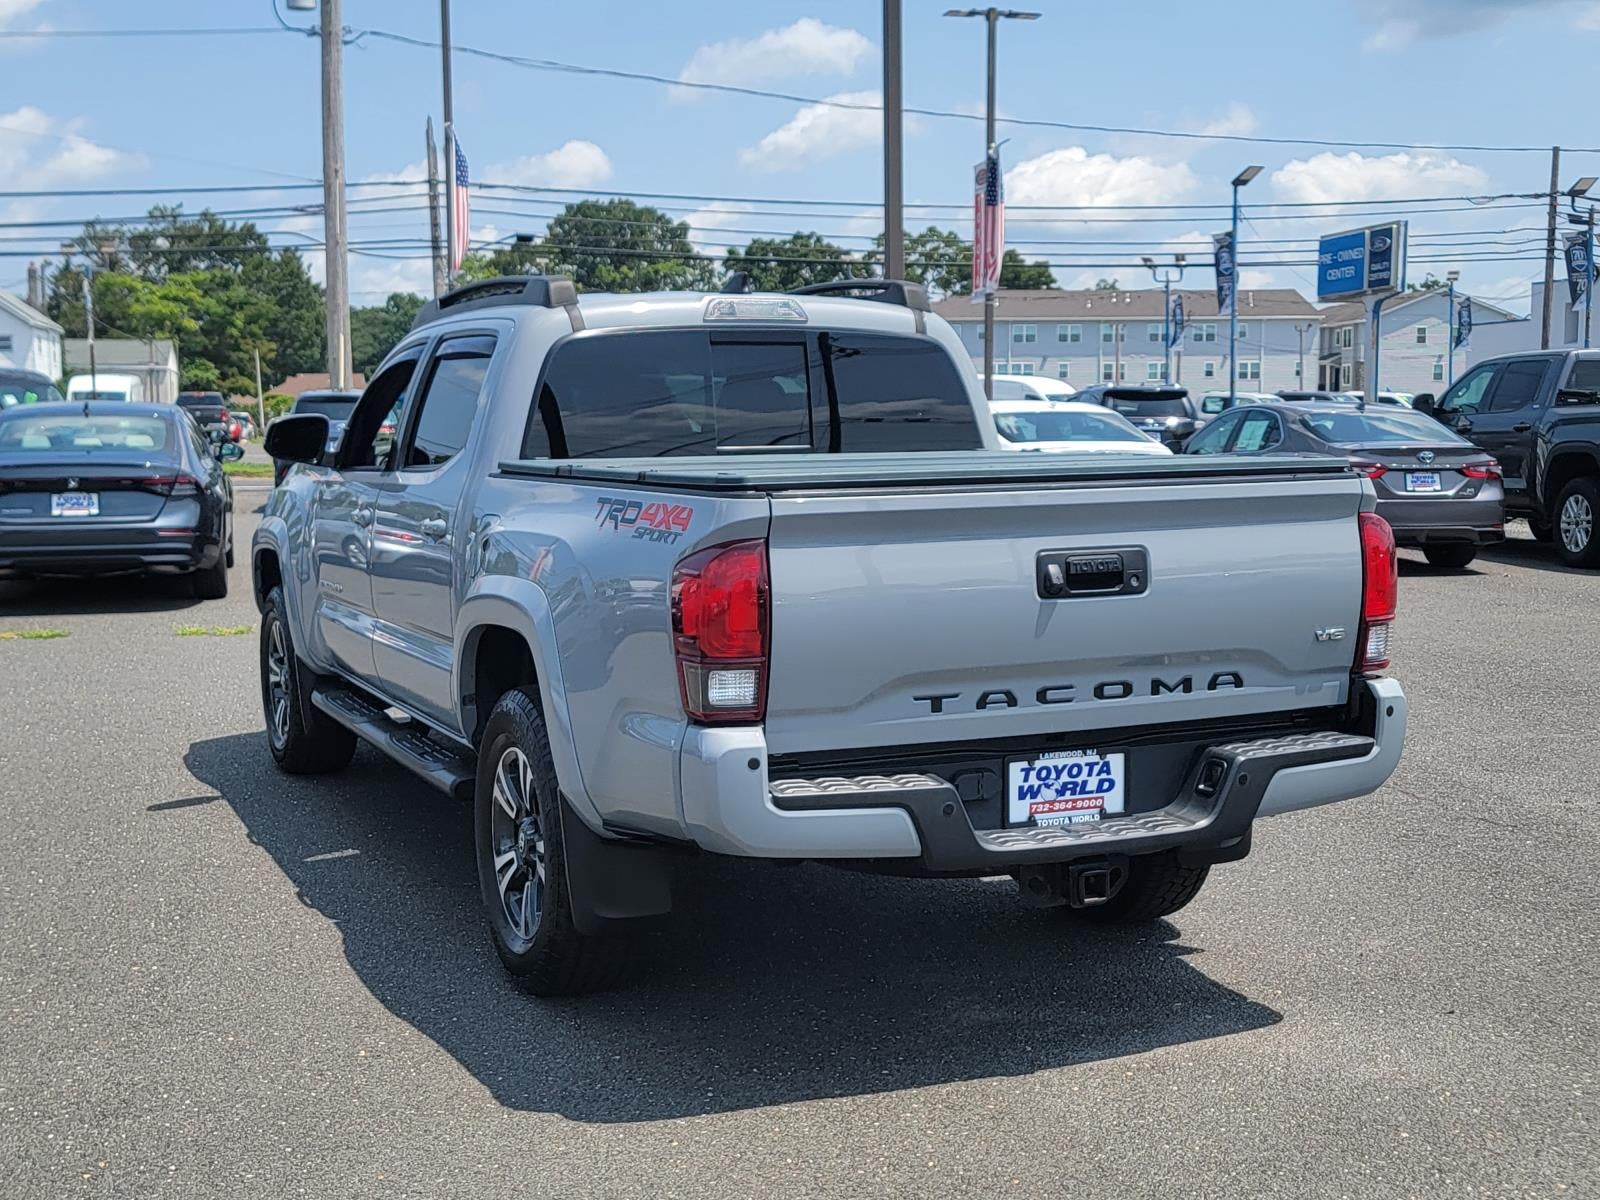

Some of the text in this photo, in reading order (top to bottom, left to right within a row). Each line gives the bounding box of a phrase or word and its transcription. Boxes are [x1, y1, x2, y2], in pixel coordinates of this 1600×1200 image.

[1326, 265, 1356, 281] CENTER
[595, 497, 643, 531] TRD
[632, 526, 684, 545] SPORT
[1071, 559, 1122, 573] TOYOTA
[1313, 628, 1345, 641] V6
[912, 670, 1245, 713] TACOMA
[1039, 748, 1097, 760] LAKEWOOD, NJ
[1020, 760, 1112, 783] TOYOTA
[1030, 798, 1103, 813] 732-364-9000
[1037, 814, 1101, 827] TOYOTA WORLD
